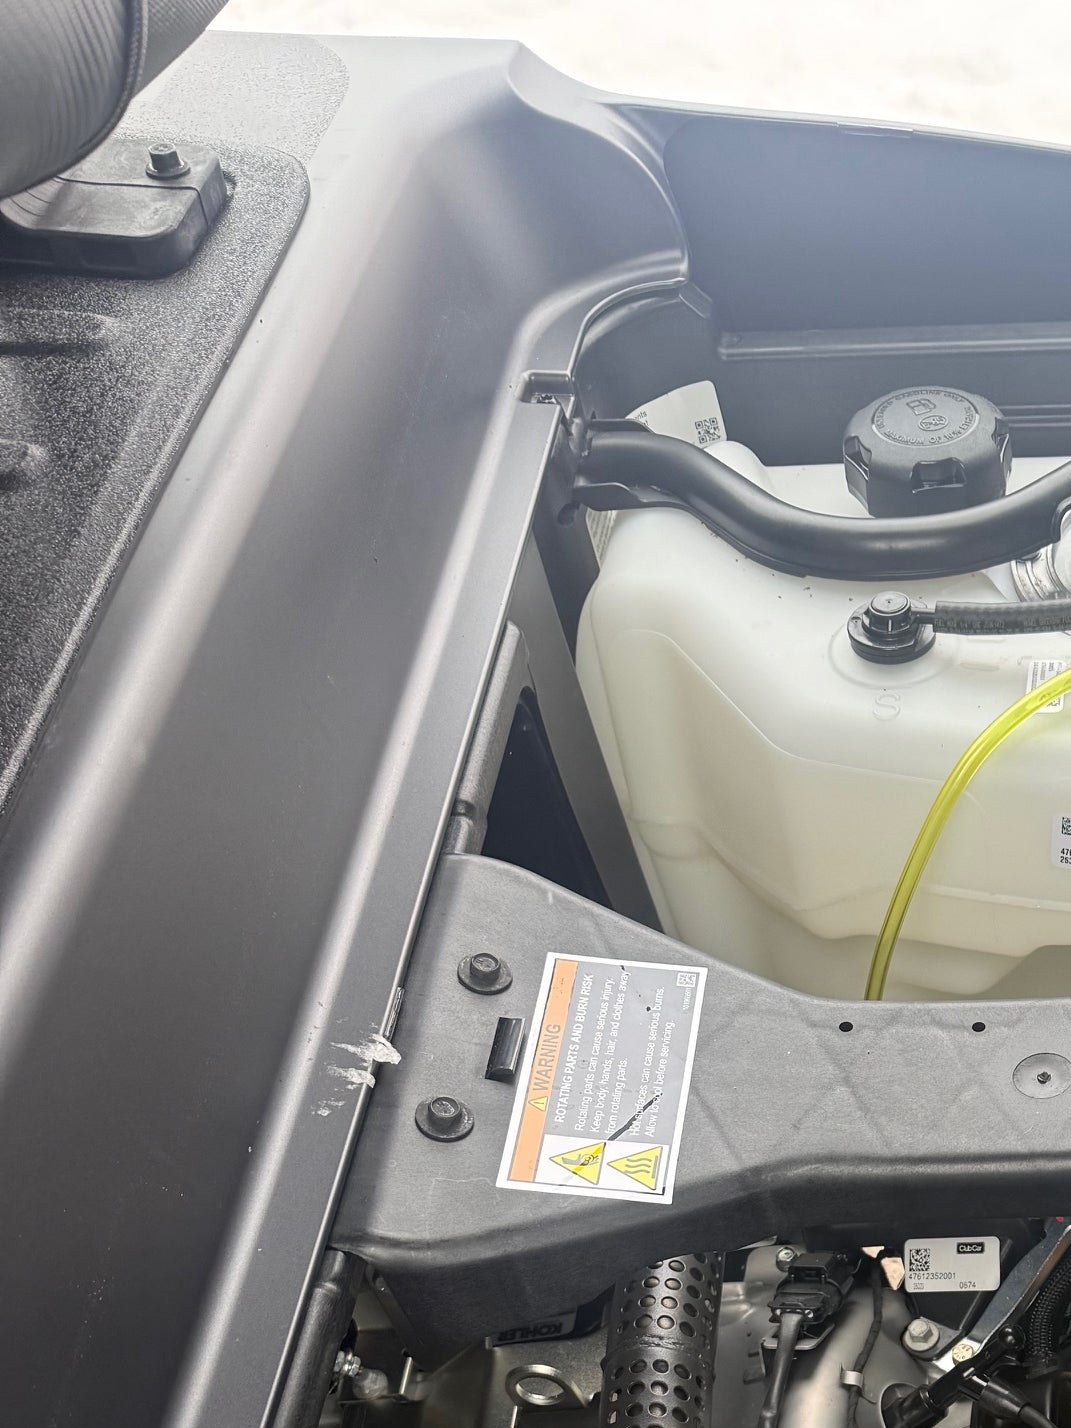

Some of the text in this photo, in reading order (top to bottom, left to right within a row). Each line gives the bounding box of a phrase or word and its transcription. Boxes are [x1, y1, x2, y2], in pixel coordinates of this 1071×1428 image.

[532, 1023, 561, 1091] WARNING
[554, 973, 593, 1122] ROTATING PARTS AND BURN RISK
